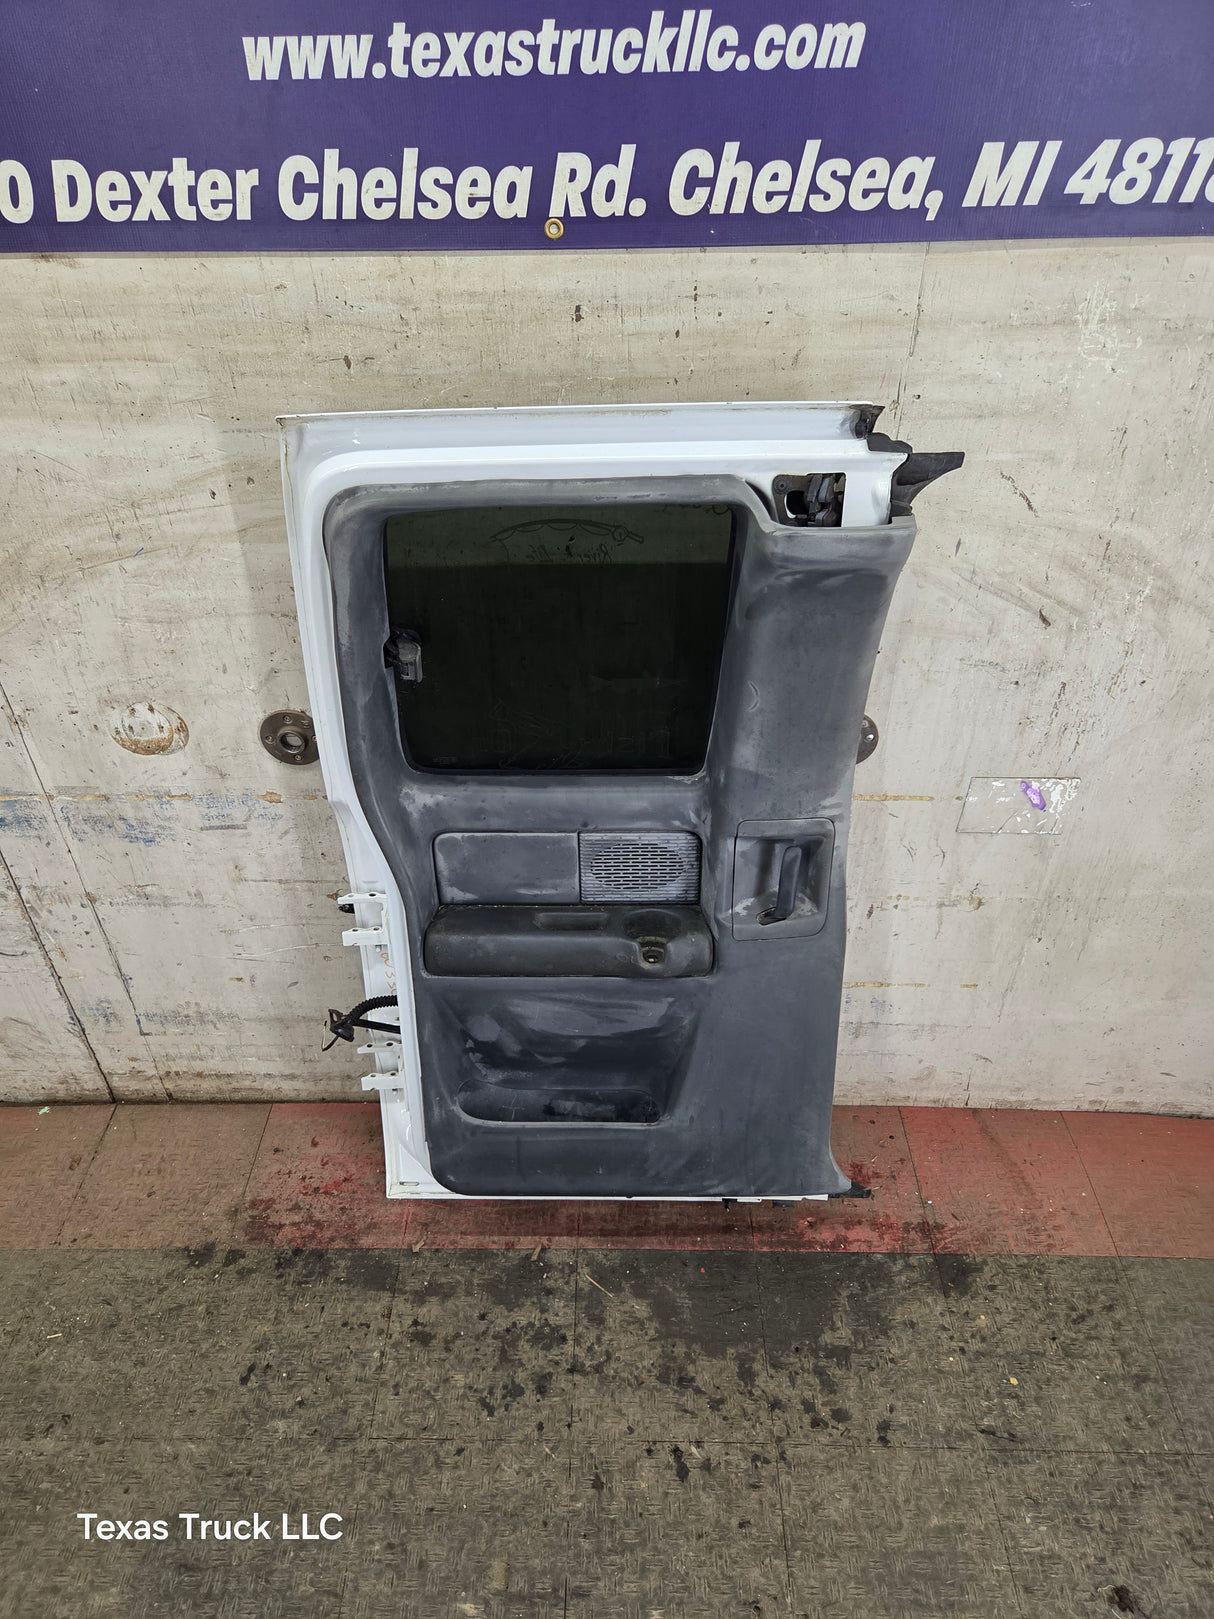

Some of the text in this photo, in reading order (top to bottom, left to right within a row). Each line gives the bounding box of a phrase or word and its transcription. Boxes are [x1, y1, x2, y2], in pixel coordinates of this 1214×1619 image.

[242, 9, 868, 80] www.texastruckllc.com
[51, 157, 259, 223] Dexter
[278, 147, 533, 221] Chelsea
[548, 143, 648, 218] Rd.
[668, 139, 944, 222] Chelsea,
[961, 140, 1063, 208] MI
